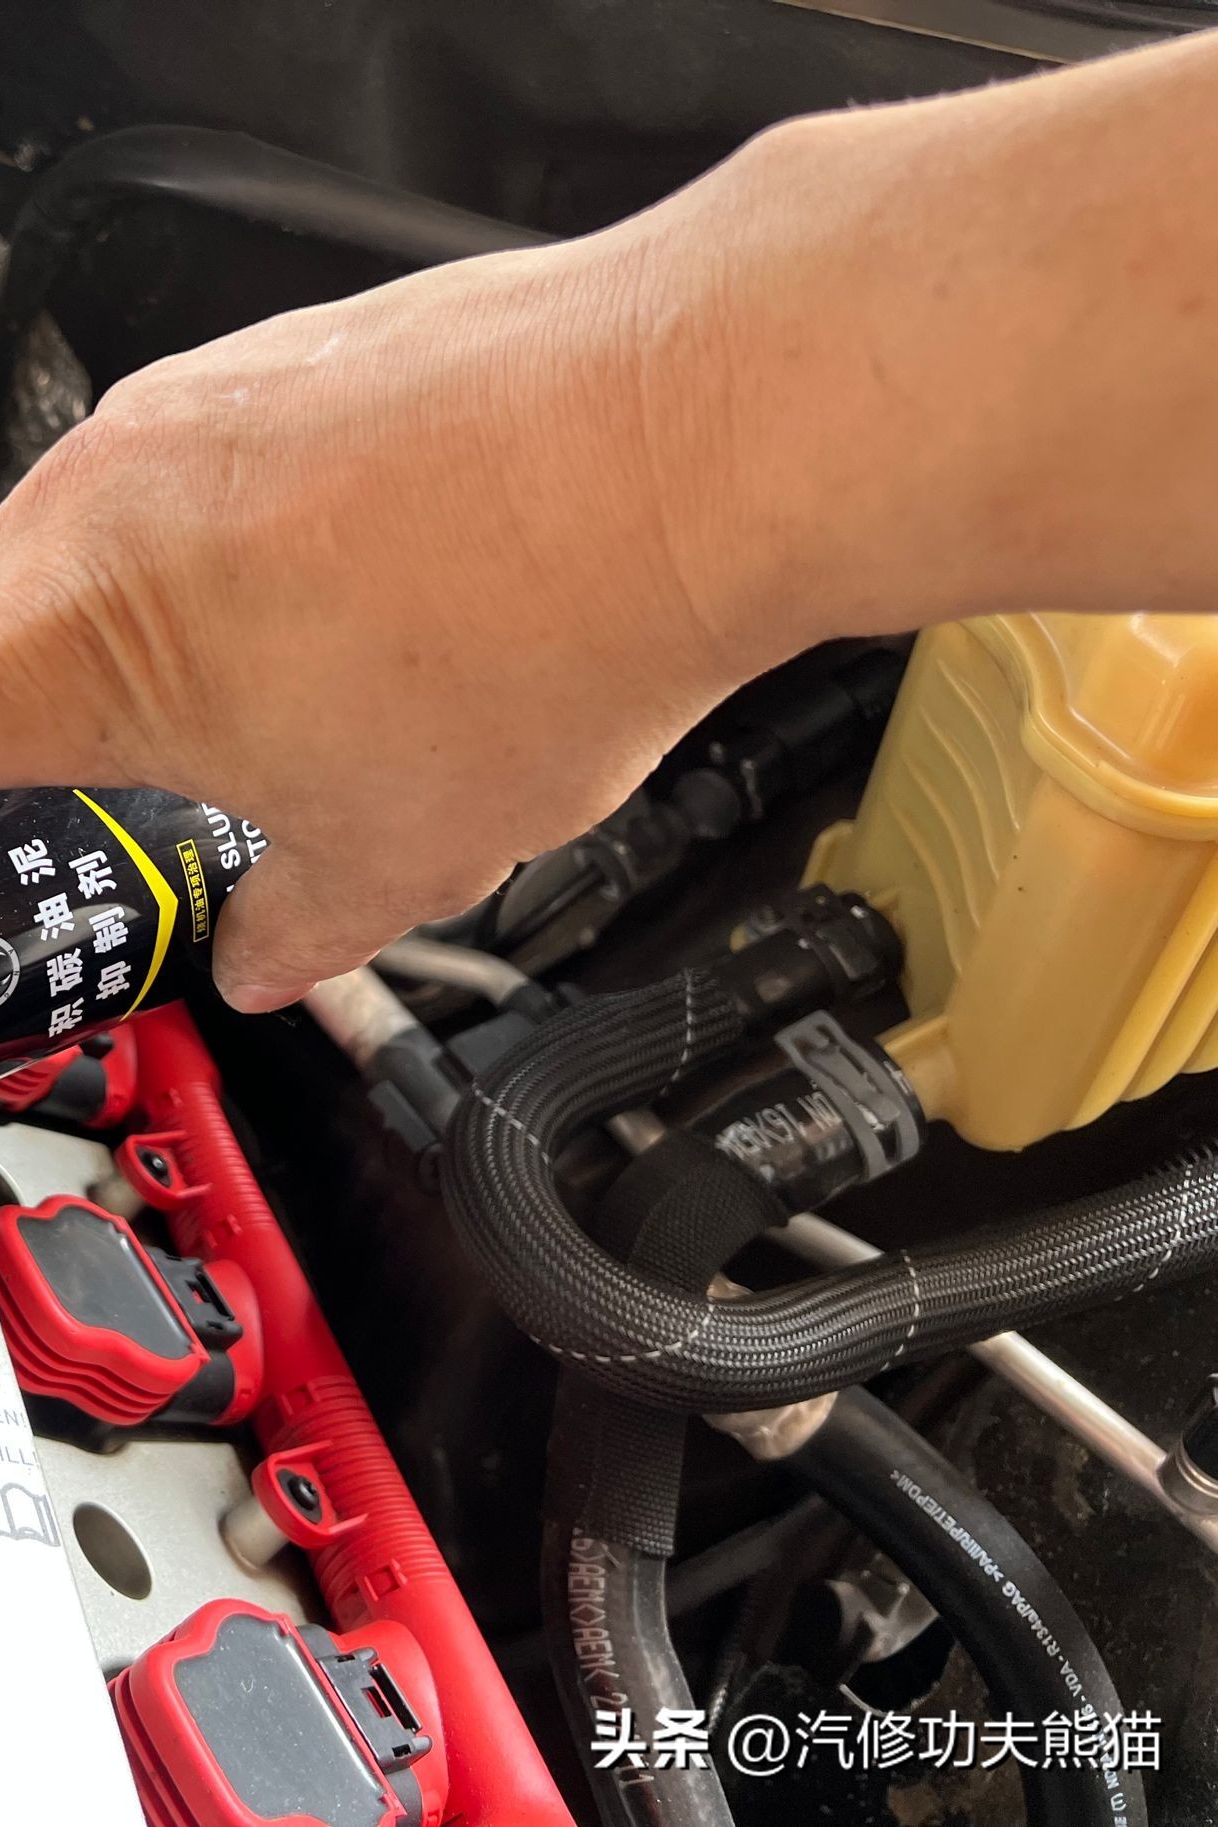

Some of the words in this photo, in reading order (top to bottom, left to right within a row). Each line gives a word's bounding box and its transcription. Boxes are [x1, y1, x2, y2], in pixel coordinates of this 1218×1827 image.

[7, 838, 85, 1038] 积碳油泥
[68, 850, 132, 1000] 抑制剂
[1001, 1580, 1061, 1657] R134a/PAG
[1059, 1660, 1083, 1698] VDA
